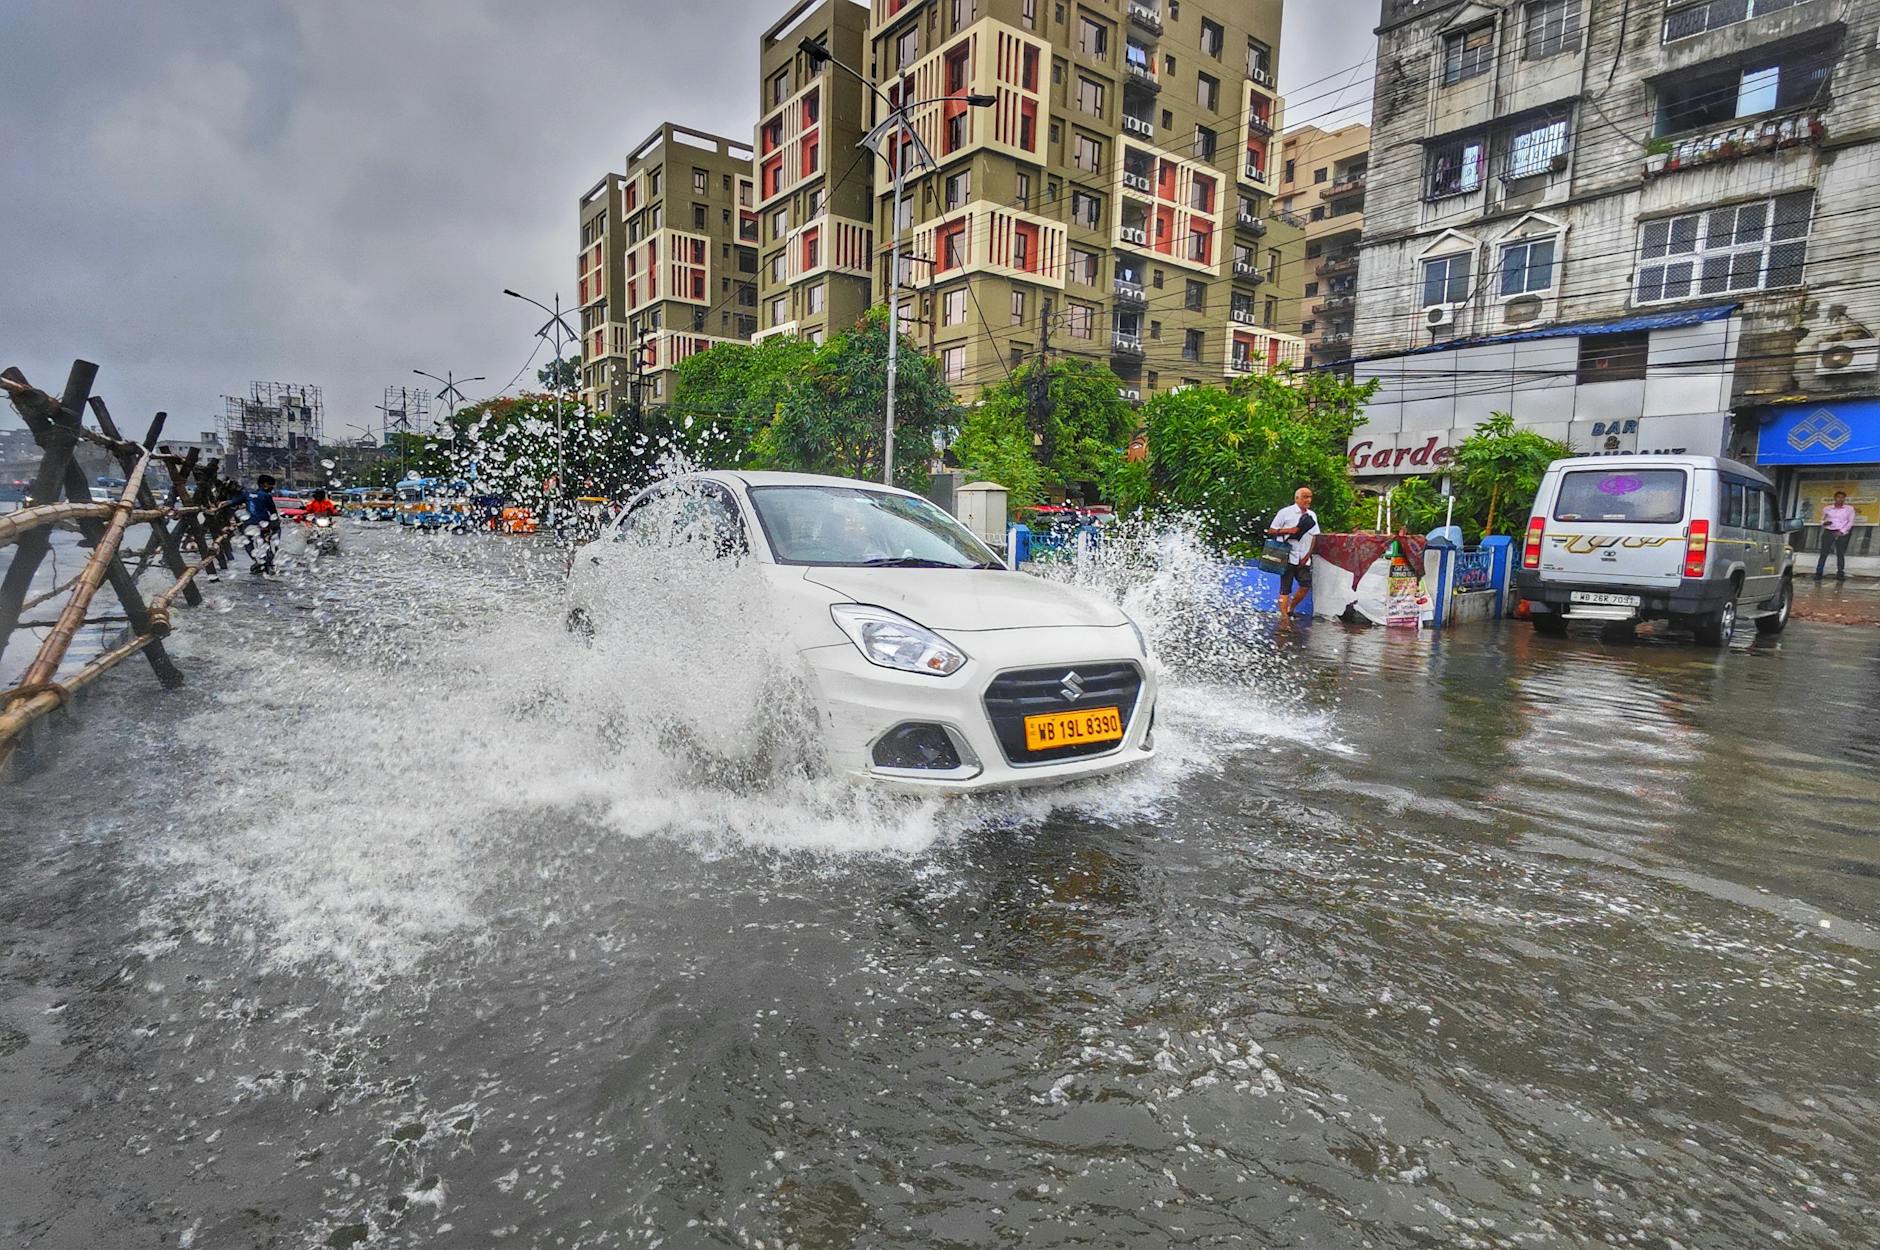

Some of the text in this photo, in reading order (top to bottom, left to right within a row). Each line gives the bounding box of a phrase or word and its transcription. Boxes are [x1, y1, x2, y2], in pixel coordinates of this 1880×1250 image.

[1591, 419, 1638, 436] BAR
[1604, 436, 1620, 449] &
[1580, 593, 1590, 602] WB
[1593, 593, 1609, 603] 26R
[1038, 722, 1055, 742] WB
[1060, 719, 1083, 739] 19L
[1086, 715, 1118, 735] 8390
